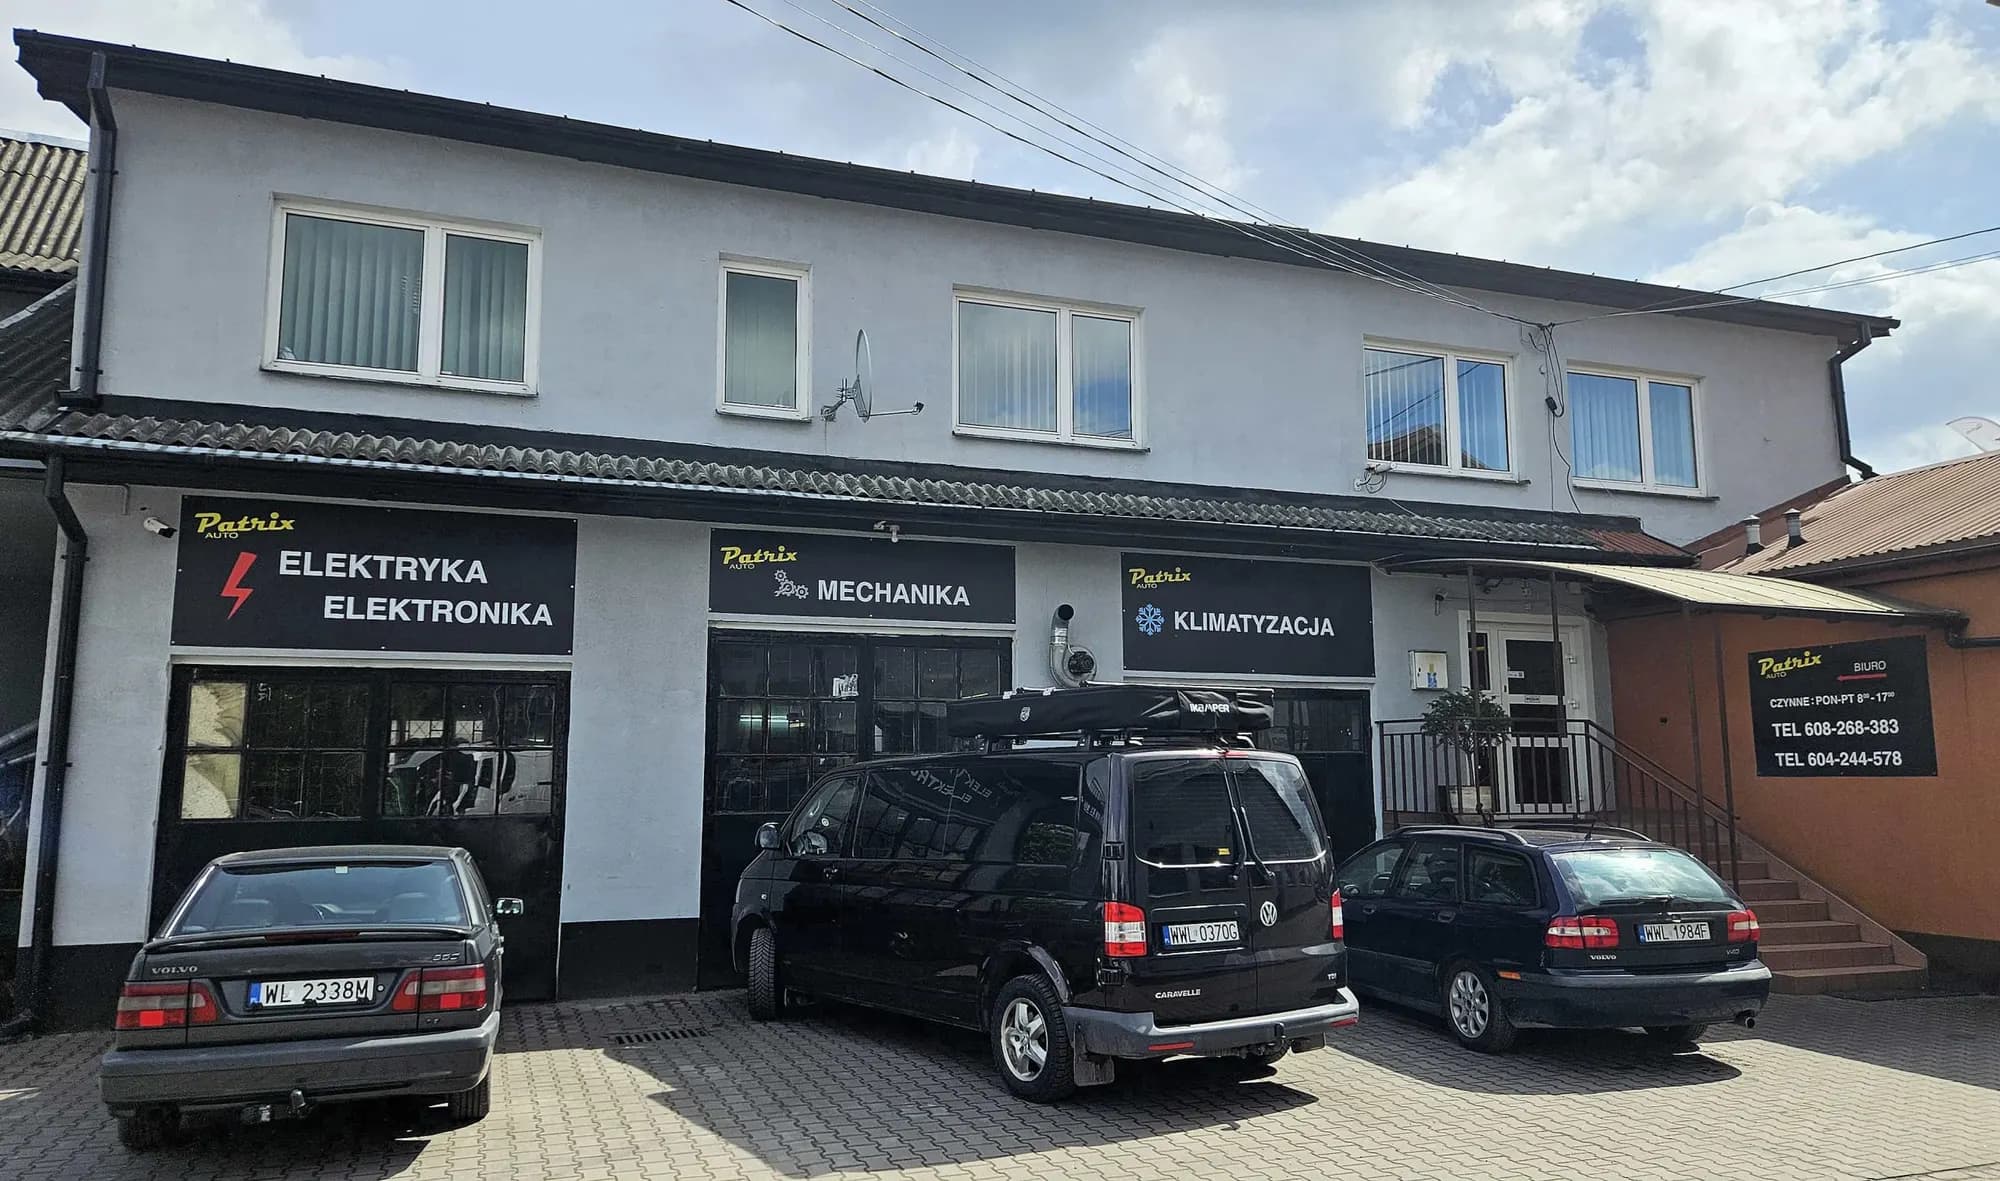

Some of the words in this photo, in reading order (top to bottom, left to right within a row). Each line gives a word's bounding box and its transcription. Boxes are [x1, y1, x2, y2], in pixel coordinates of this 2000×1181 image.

[194, 511, 295, 534] Patrix
[205, 531, 239, 540] AUTO
[720, 545, 797, 565] Patrix
[279, 550, 488, 584] ELEKTRYKA
[1129, 567, 1191, 585] Patrix
[818, 580, 970, 606] MECHANIKA
[323, 596, 553, 627] ELEKTRONIKA
[1174, 611, 1335, 637] KLIMATYZACJA
[1758, 651, 1822, 675] Patrix
[1854, 660, 1887, 673] BIURO
[1766, 671, 1787, 680] AUTO
[1771, 722, 1802, 738] TEL
[1804, 719, 1900, 737] 608-268-383
[1774, 752, 1805, 767] TEL
[1807, 750, 1903, 767] 604-244-578
[1170, 924, 1197, 945] WWL
[1645, 925, 1670, 941] WWL
[1673, 923, 1708, 939] 1984F
[151, 965, 198, 974] VOLVO
[265, 984, 292, 1004] WL
[301, 979, 369, 1001] 2338M
[1154, 988, 1201, 999] CARAVELLE
